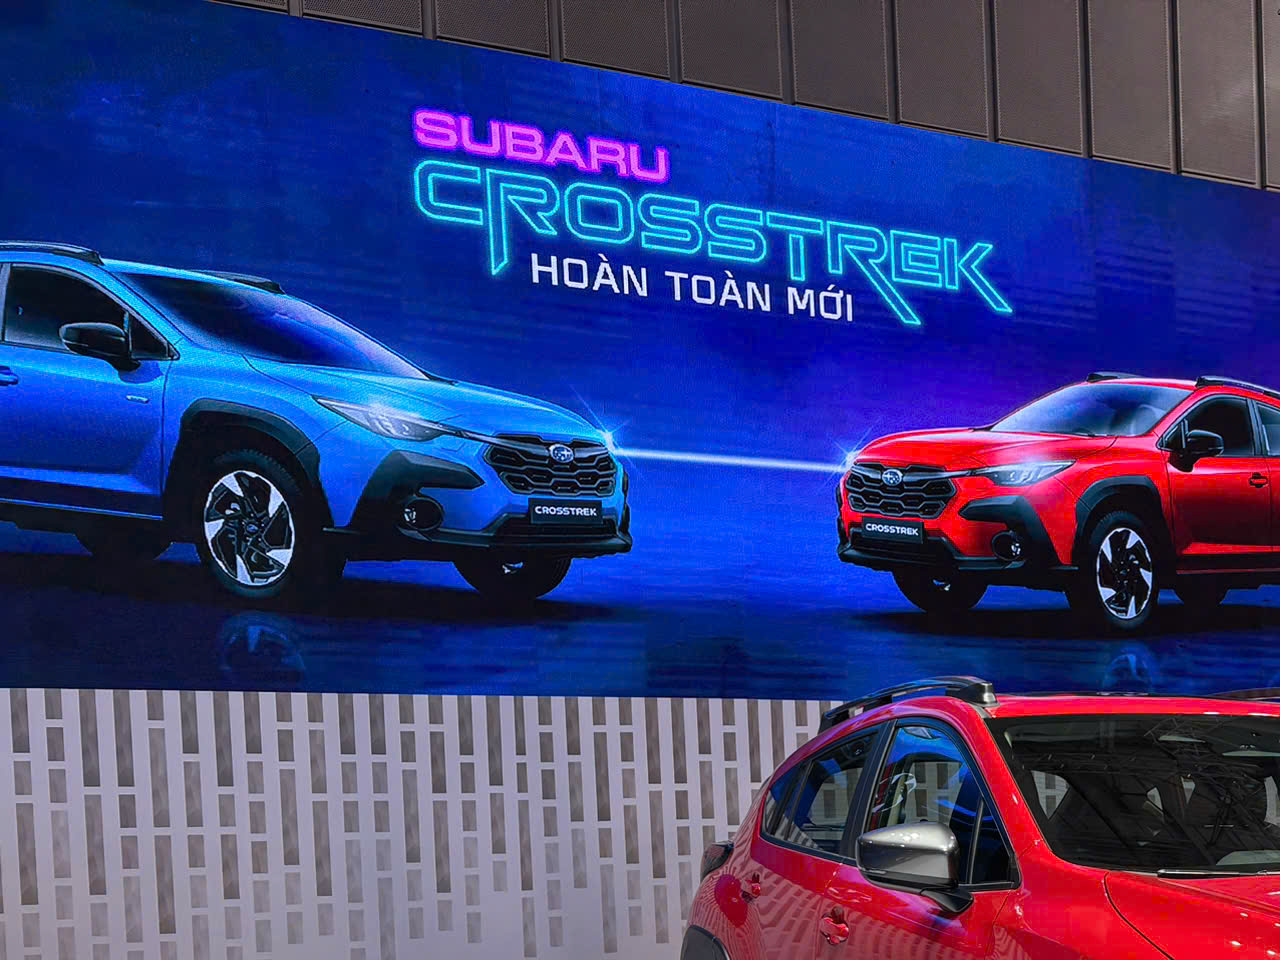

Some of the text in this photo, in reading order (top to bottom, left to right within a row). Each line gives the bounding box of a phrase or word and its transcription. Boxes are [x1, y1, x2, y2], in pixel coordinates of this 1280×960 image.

[414, 109, 669, 183] SUBARU
[413, 159, 1013, 325] CROSSTREK
[530, 253, 853, 322] HOÀN TOÀN MỚI
[534, 505, 598, 517] CROSSTREK
[865, 523, 919, 536] CROSSTREK
